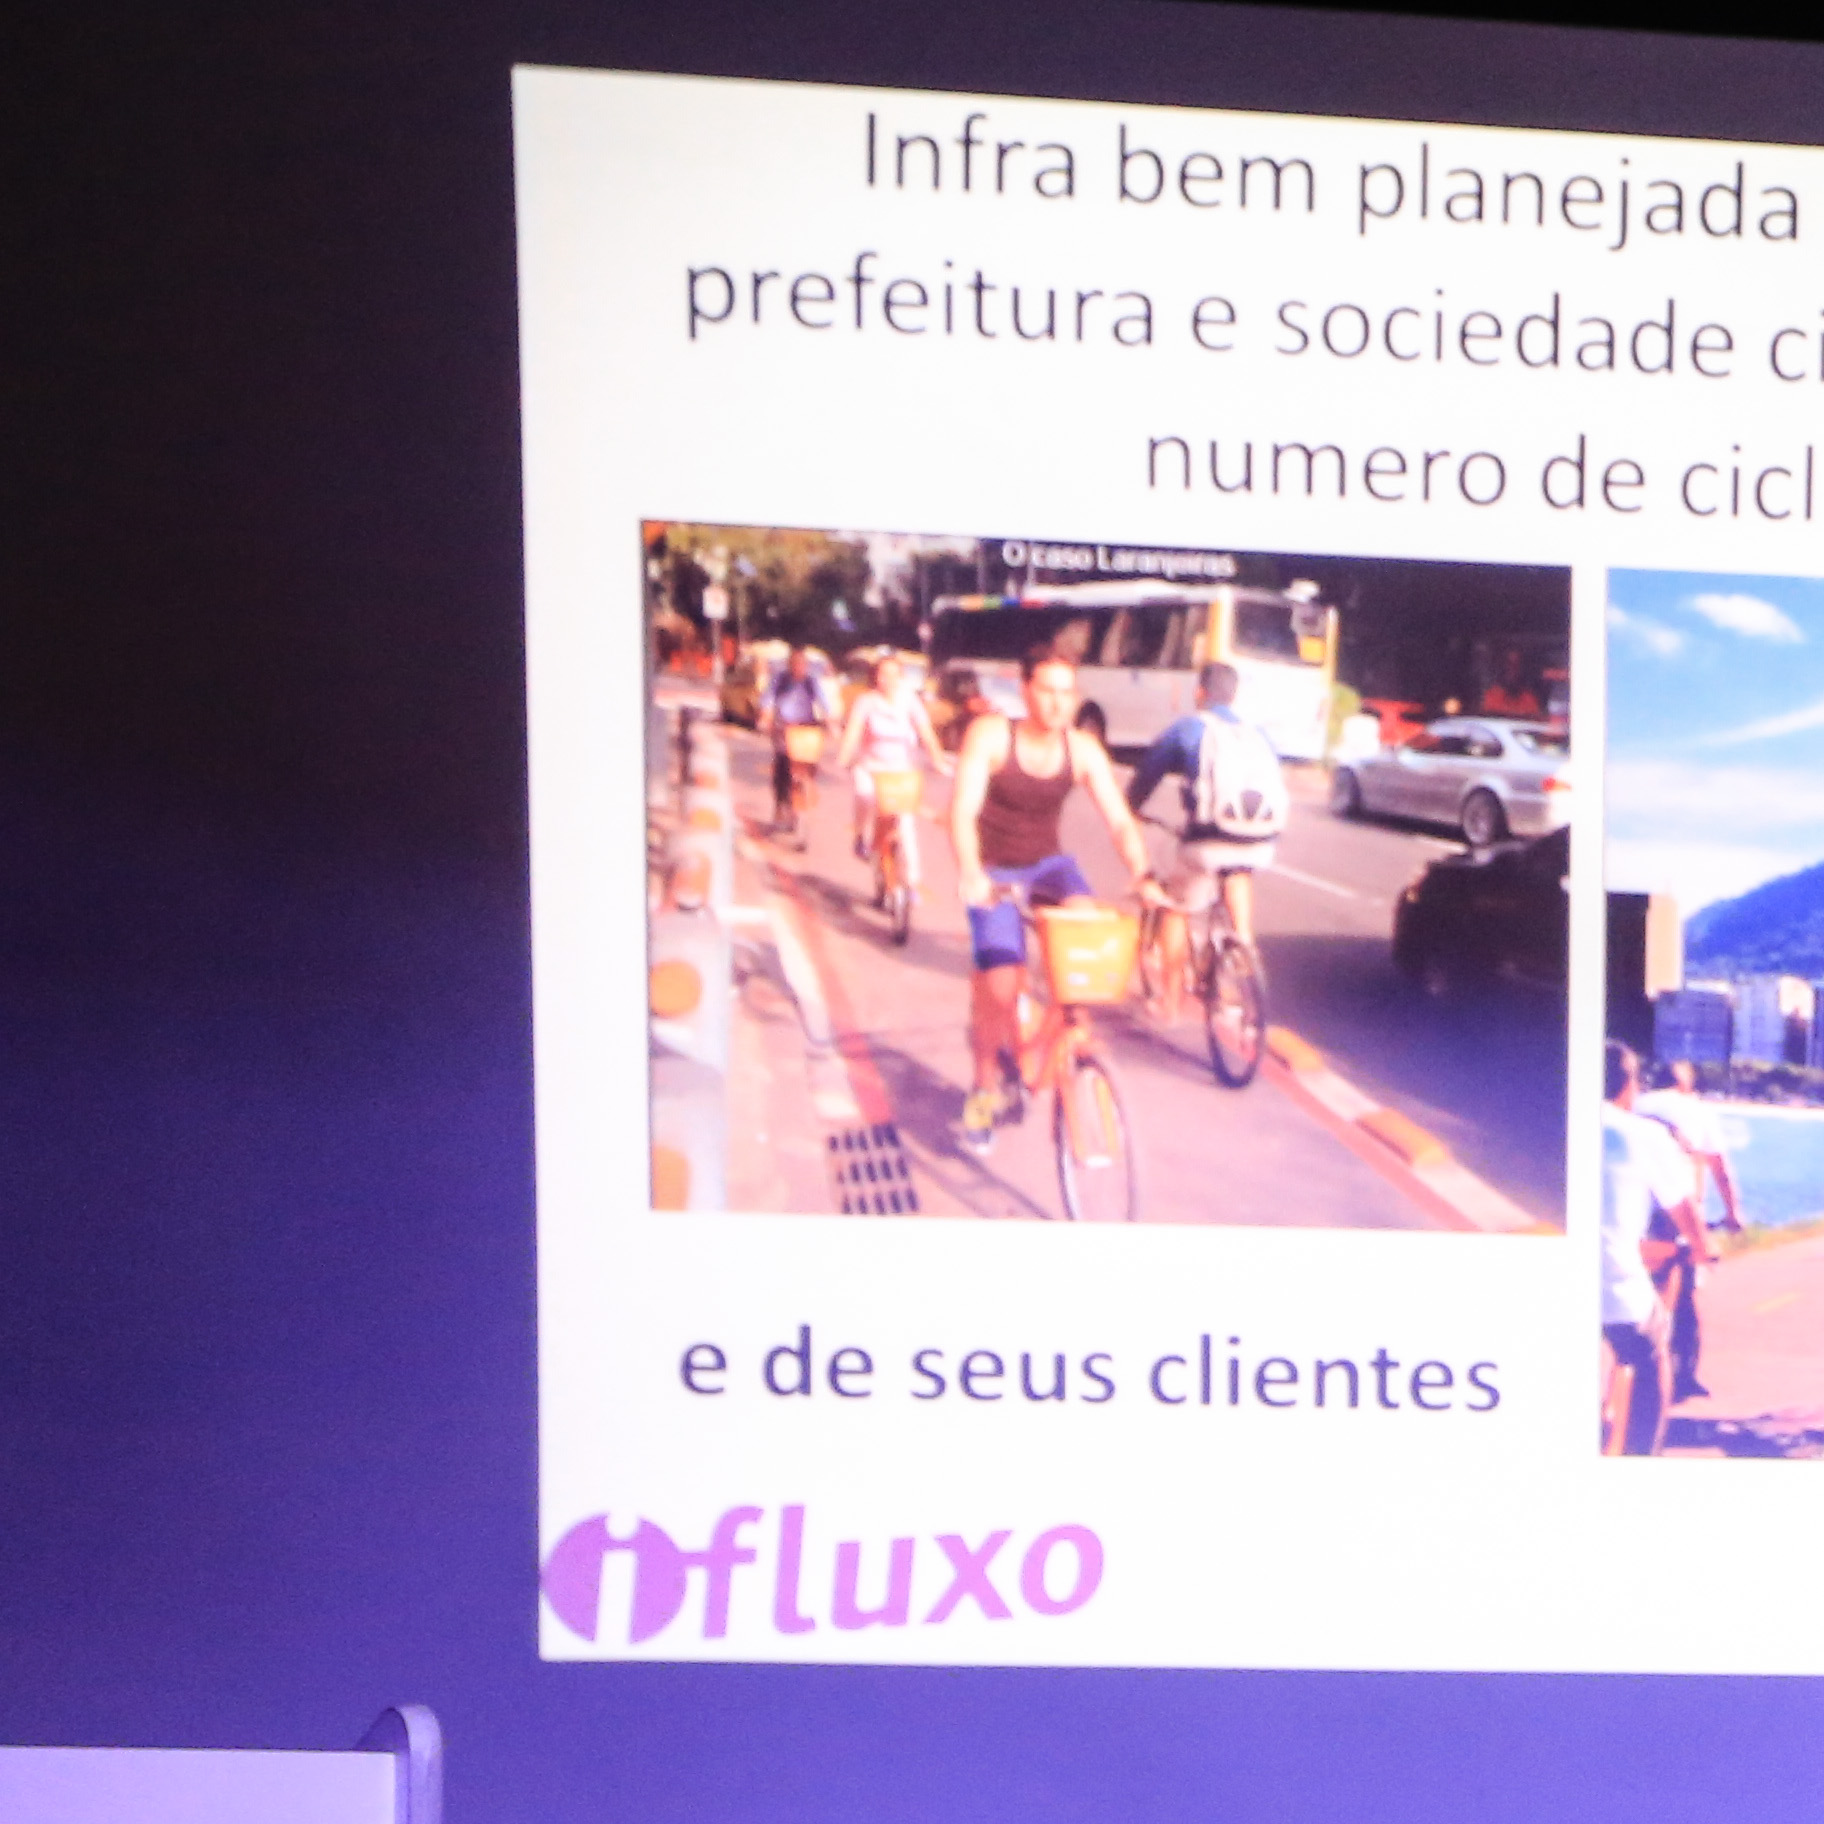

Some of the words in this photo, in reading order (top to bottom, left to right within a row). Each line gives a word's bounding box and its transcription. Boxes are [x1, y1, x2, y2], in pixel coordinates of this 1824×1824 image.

[867, 112, 1075, 198] Infra
[1119, 124, 1314, 212] bem
[1359, 143, 1800, 251] planejada
[687, 252, 1152, 346] prefeitura
[1192, 297, 1236, 351] e
[1278, 289, 1733, 377] sociedade
[1149, 436, 1506, 506] numero
[1542, 434, 1645, 512] de
[1002, 540, 1027, 568] O
[679, 1343, 727, 1395] e
[762, 1324, 873, 1398] de
[912, 1349, 1115, 1403] seus
[1149, 1334, 1500, 1412] clientes
